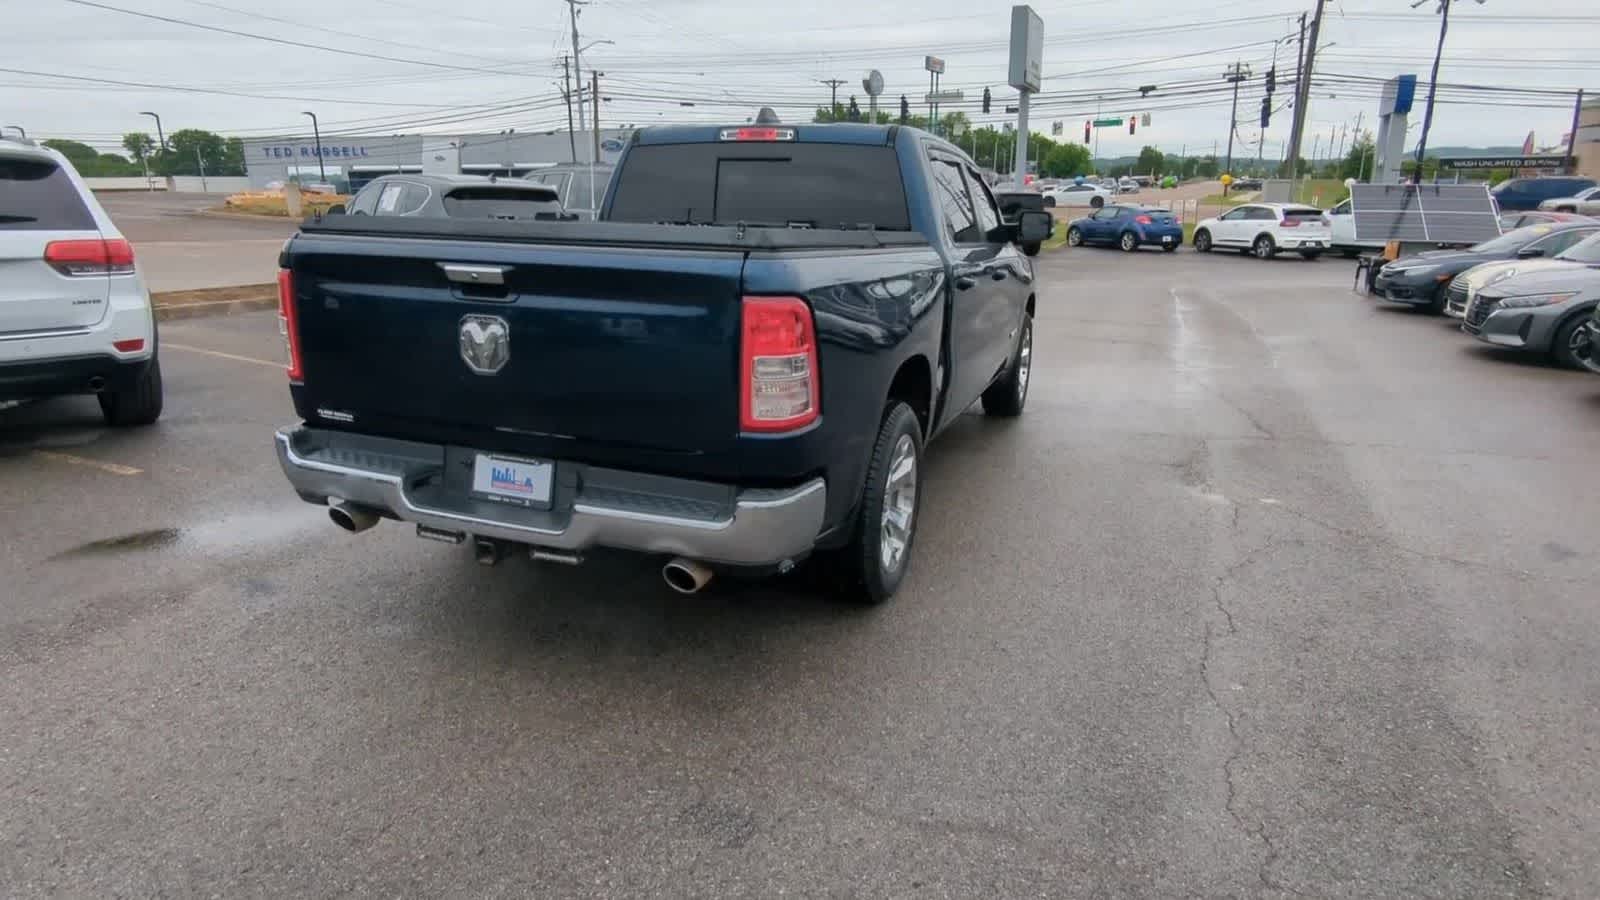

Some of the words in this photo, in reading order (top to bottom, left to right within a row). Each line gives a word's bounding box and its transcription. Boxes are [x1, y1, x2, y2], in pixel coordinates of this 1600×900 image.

[262, 147, 293, 158] TED
[301, 146, 369, 157] RUSSELL
[1453, 159, 1477, 167] WASH
[1478, 159, 1522, 167] UNLIMITED
